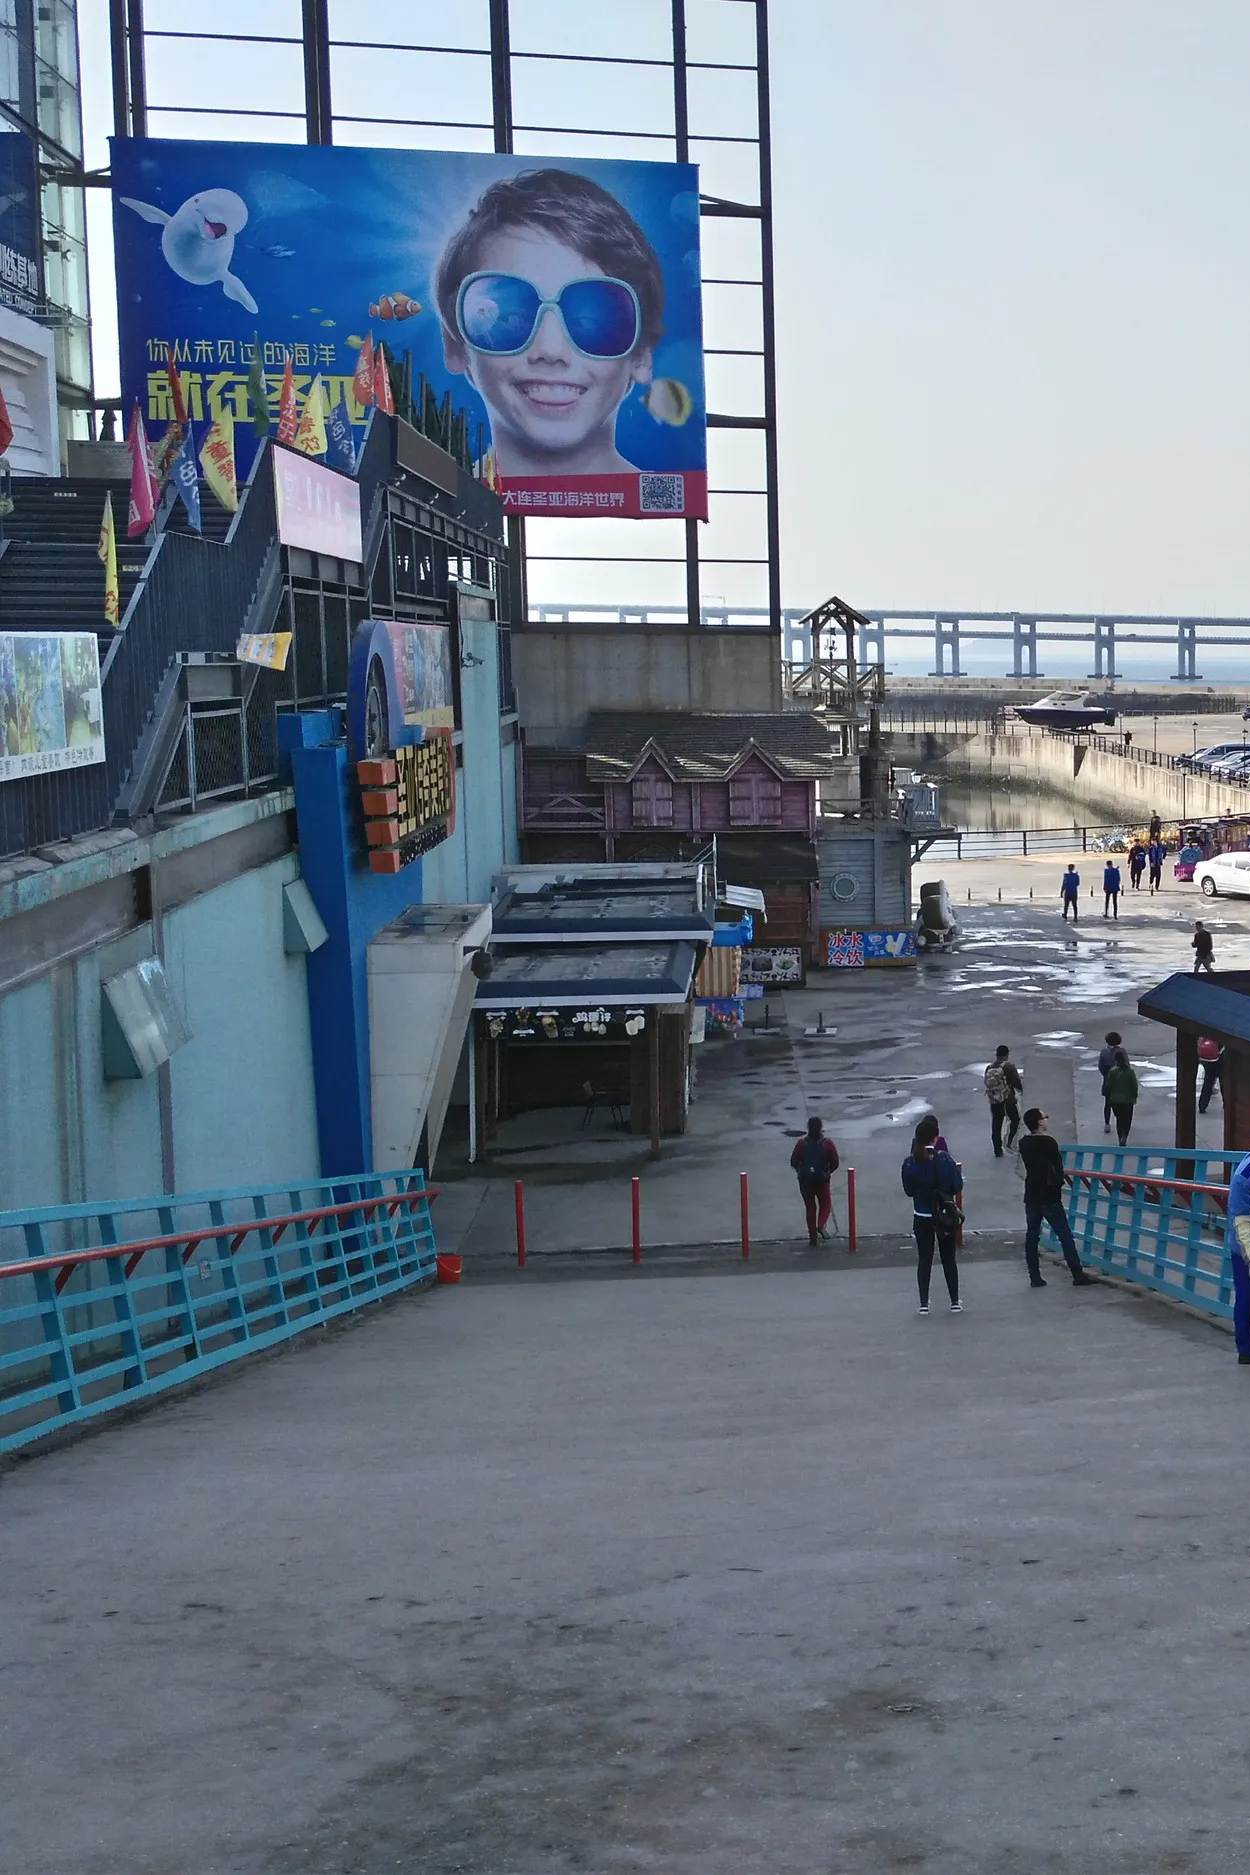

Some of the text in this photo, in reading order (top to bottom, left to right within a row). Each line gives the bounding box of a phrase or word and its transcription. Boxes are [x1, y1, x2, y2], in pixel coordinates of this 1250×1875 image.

[146, 338, 337, 367] 你从未见过的海洋
[502, 490, 625, 508] 大连圣亚海洋世界
[828, 931, 864, 948] 冰水
[828, 950, 864, 967] 冷饮
